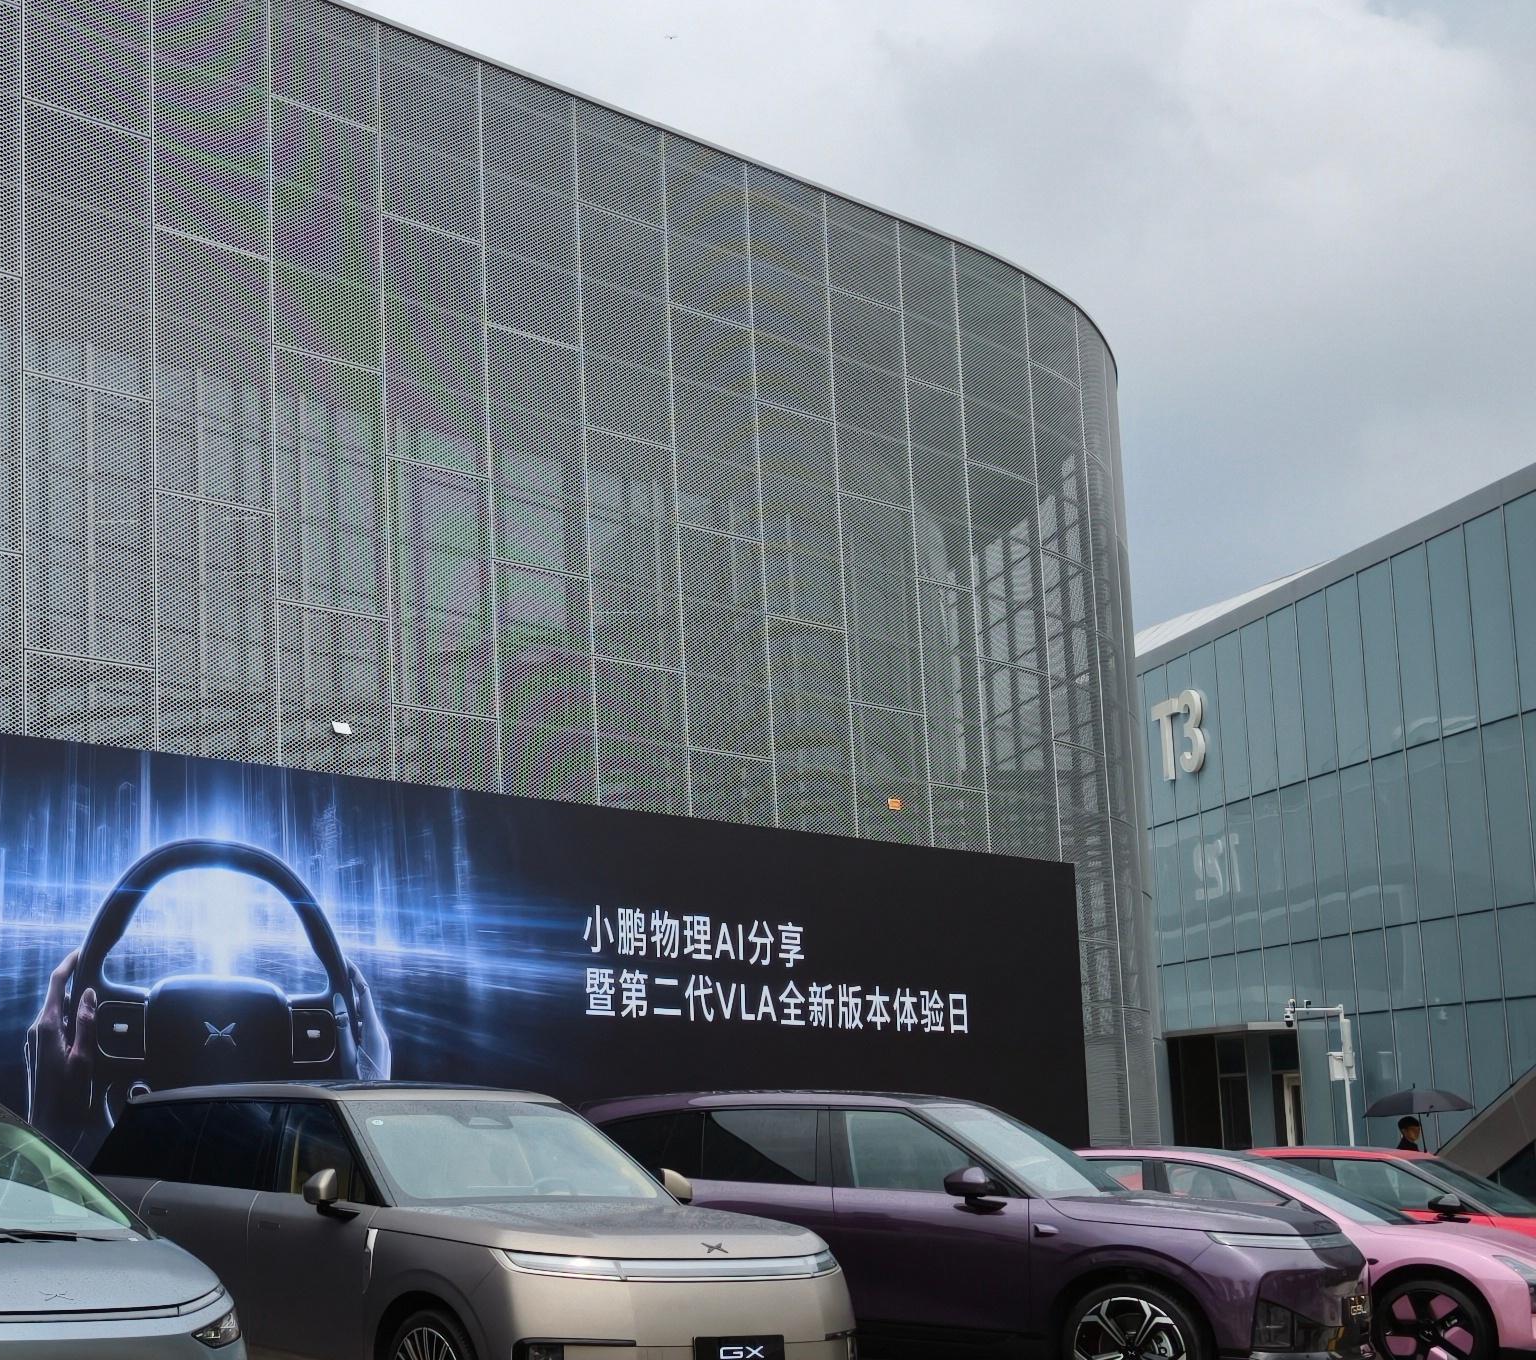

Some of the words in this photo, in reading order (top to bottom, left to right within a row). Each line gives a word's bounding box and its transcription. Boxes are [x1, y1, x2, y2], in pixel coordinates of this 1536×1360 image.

[1151, 689, 1206, 781] T3
[583, 904, 805, 968] 小鹏物理AI分享
[585, 967, 969, 1034] 暨第二代VLA全新版本体验日
[719, 1345, 765, 1360] GX
